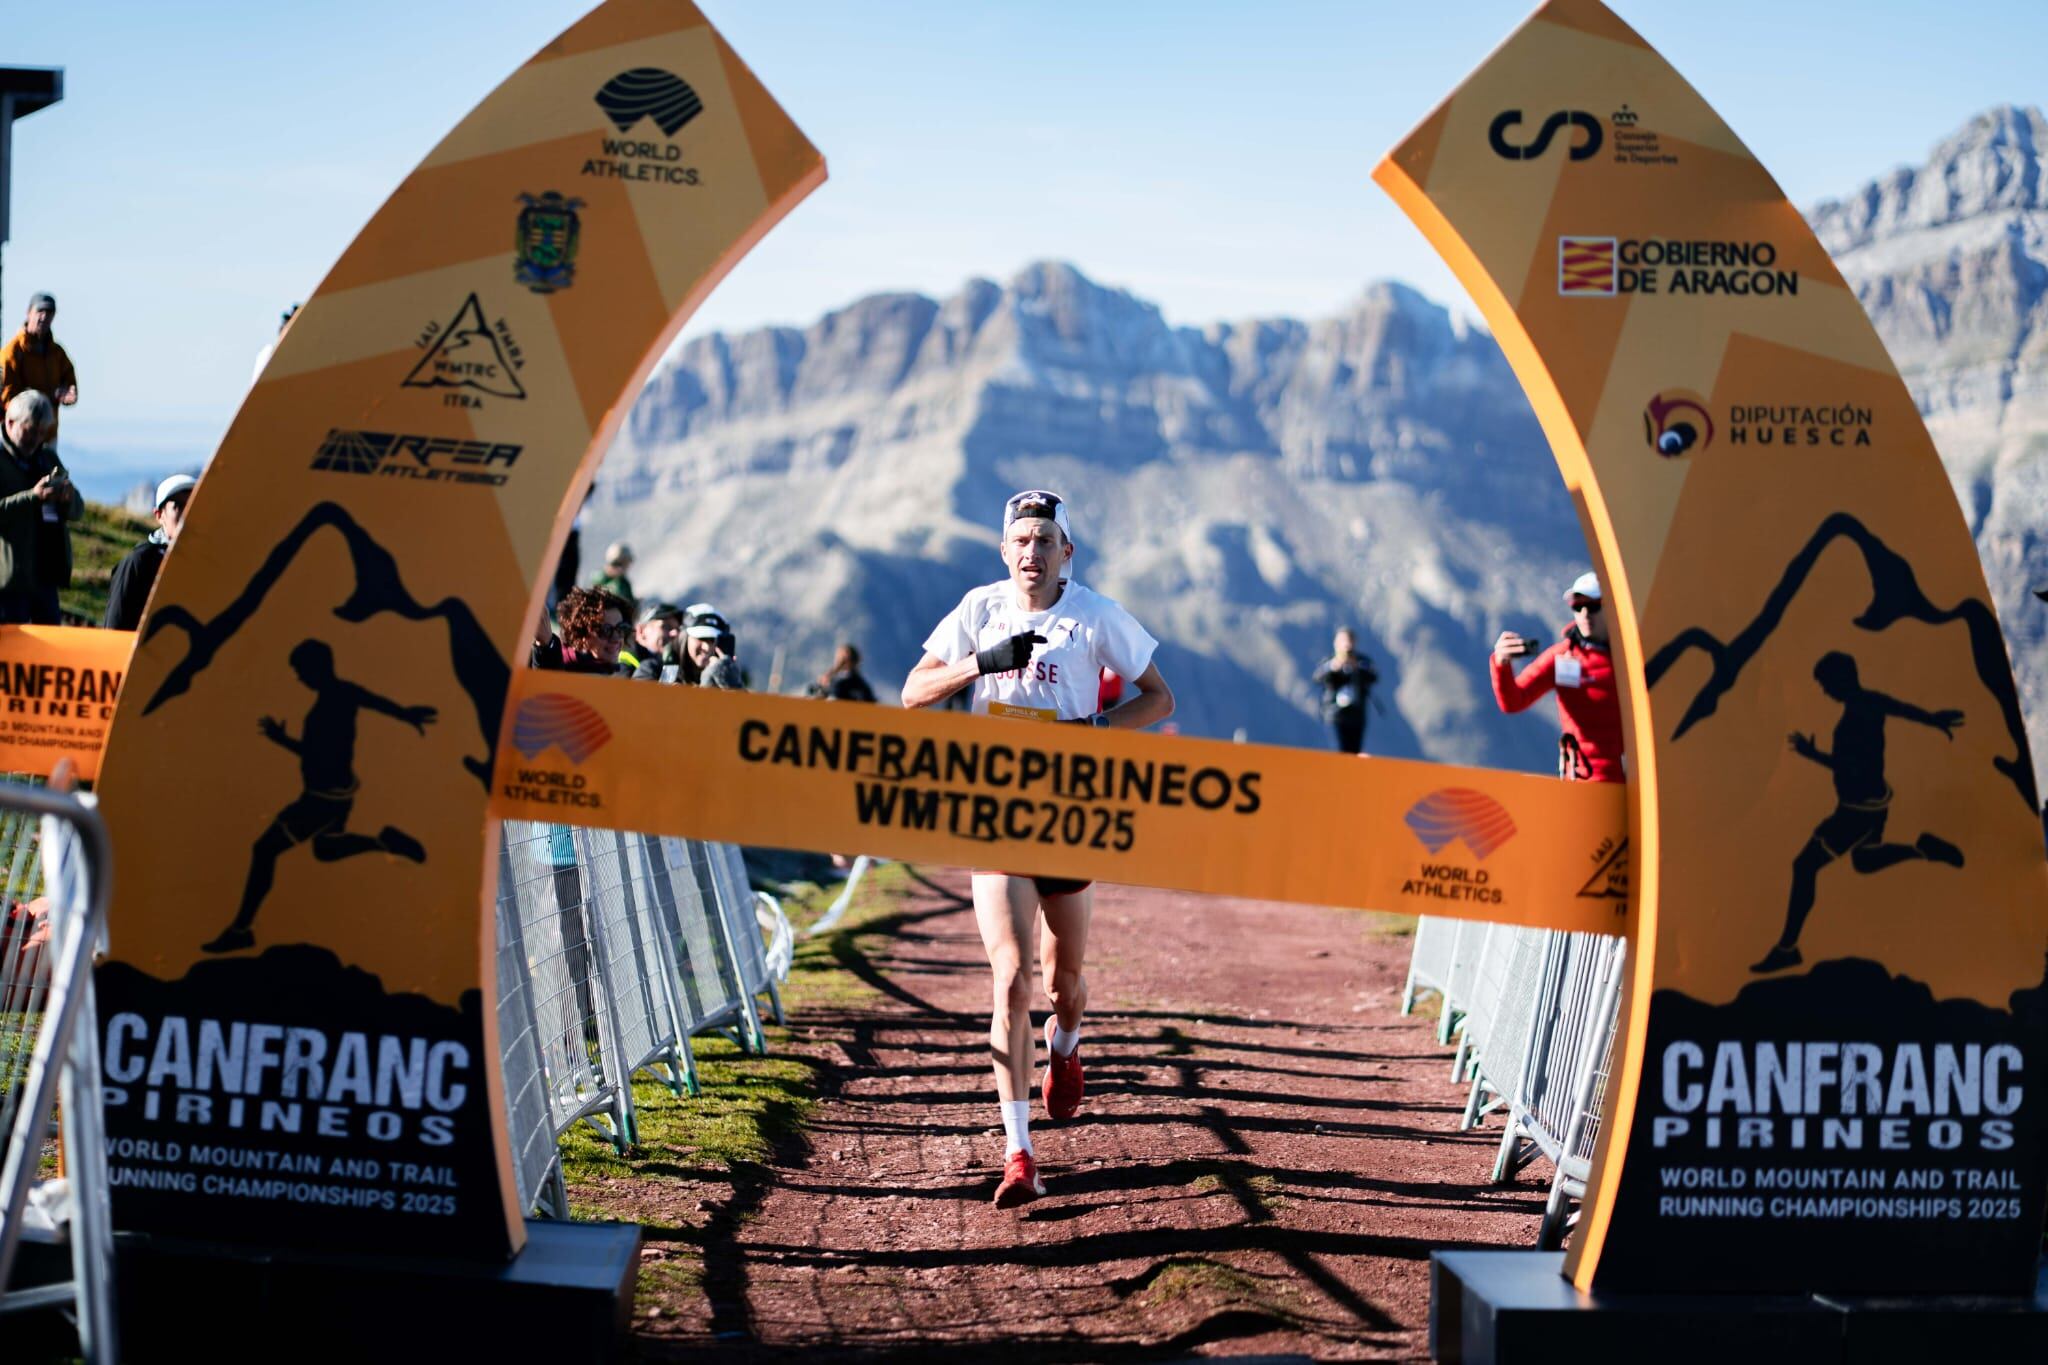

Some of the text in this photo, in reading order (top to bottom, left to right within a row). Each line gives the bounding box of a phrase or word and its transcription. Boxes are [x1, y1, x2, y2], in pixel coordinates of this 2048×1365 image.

[602, 138, 681, 161] WORLD
[581, 159, 699, 186] ATHLETICS
[1617, 239, 1776, 268] GOBIERNO
[1617, 270, 1798, 296] DE ARAGON
[414, 320, 441, 350] IAU
[432, 360, 497, 379] WMTRC
[443, 394, 483, 410] ITRA
[1730, 403, 1872, 425] DIPUTACIÓN
[1730, 427, 1872, 446] HUESCA
[518, 769, 587, 789] WORLD
[738, 719, 1262, 816] CANFRANCPIRINEOS
[855, 781, 1135, 852] WMTRC2025
[1421, 864, 1488, 885] WORLD
[1402, 880, 1503, 904] ATHLETICS
[104, 1012, 470, 1112] CANFRANC
[1662, 1041, 2024, 1115] CANFRANC
[101, 1086, 456, 1146] PIRINEOS
[1652, 1117, 2015, 1150] PIRINEOS
[189, 1145, 321, 1174] MOUNTAIN
[328, 1158, 381, 1180] AND
[388, 1163, 458, 1187] TRAIL
[1660, 1167, 2021, 1190] WORLD MOUNTAIN AND TRAIL
[107, 1165, 457, 1216] UNNING CHAMPIONSHIPS 2025
[1660, 1196, 2021, 1219] RUNNING CHAMPIONSHIPS 2025
